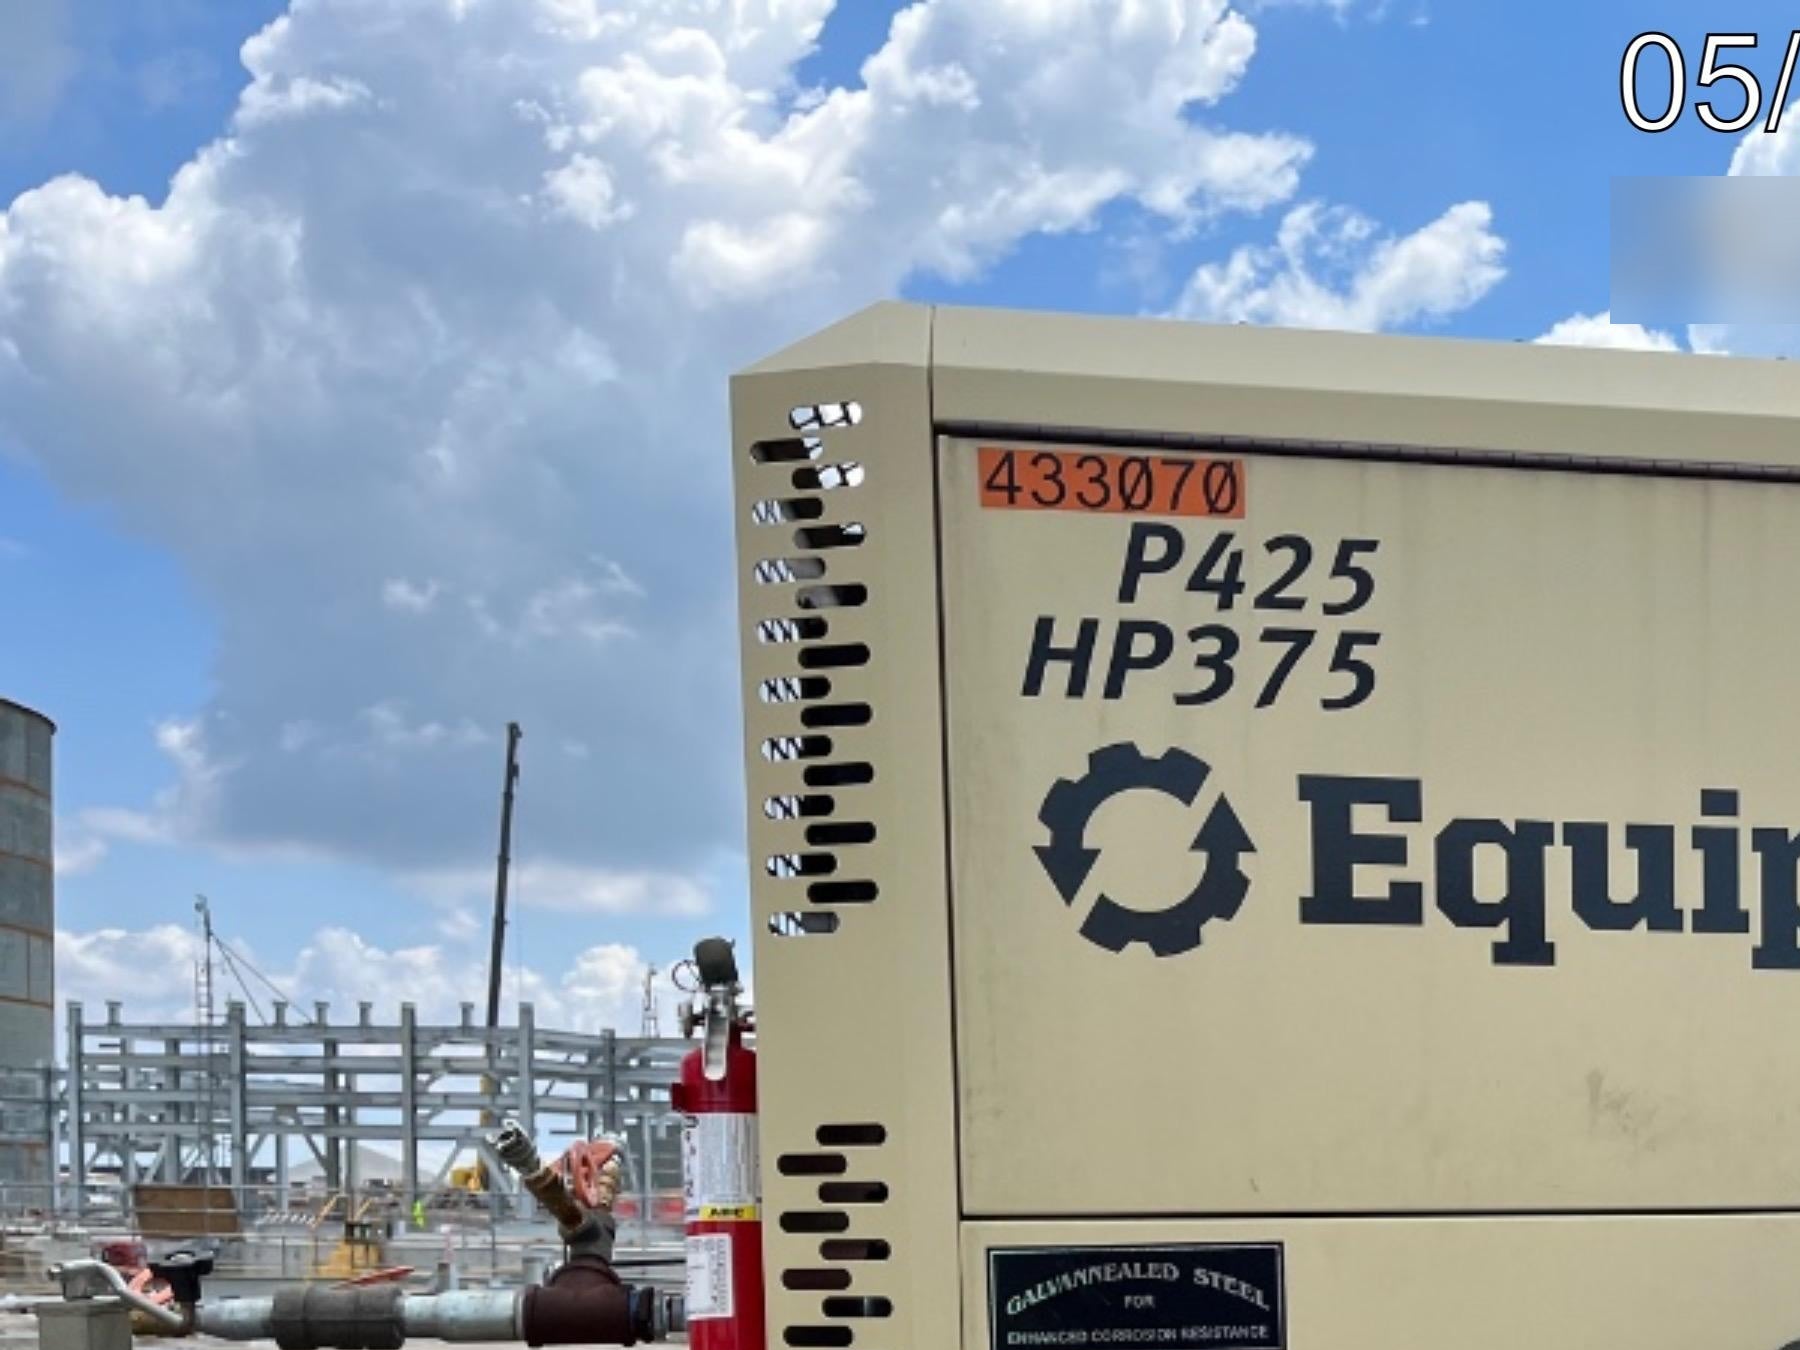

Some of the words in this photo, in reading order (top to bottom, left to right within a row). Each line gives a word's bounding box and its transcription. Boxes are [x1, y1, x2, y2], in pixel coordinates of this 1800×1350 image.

[984, 449, 1240, 515] 433070
[1118, 521, 1380, 616] P425
[1021, 614, 1382, 711] HP375
[1006, 1262, 1180, 1316] GALVANNEALED
[1193, 1267, 1271, 1312] STEEL
[1124, 1295, 1155, 1309] FOR
[1007, 1330, 1089, 1345] ENHANCED
[1091, 1327, 1178, 1343] CORROSION
[1181, 1324, 1270, 1340] RESISTANCE
